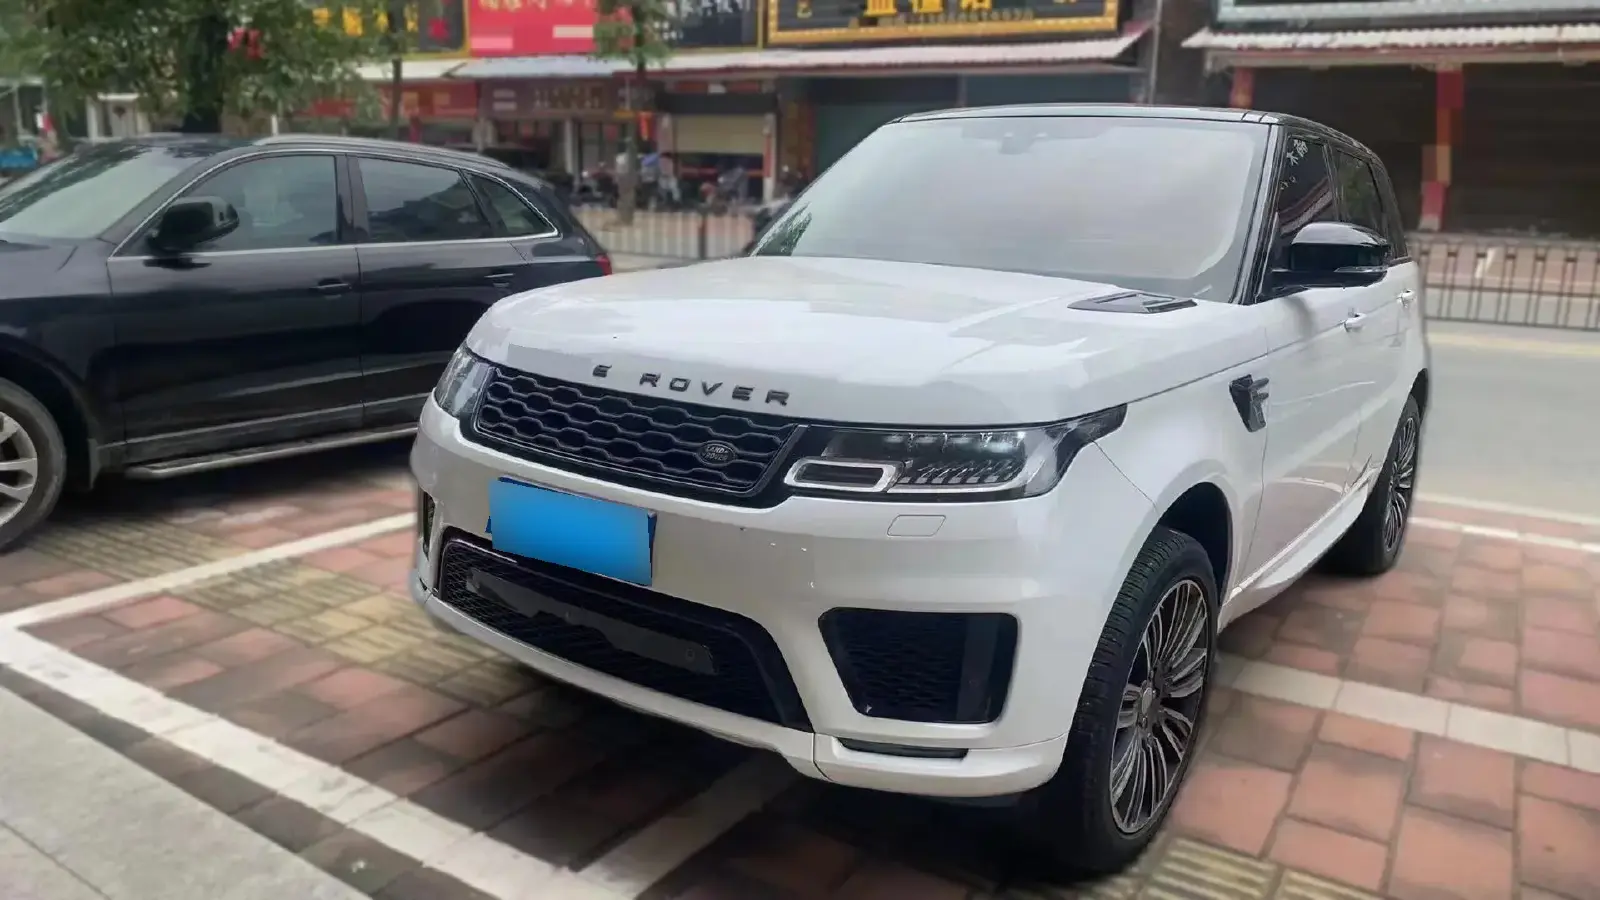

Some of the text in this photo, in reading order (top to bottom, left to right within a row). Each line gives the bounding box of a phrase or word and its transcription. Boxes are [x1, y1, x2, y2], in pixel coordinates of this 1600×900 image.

[593, 364, 790, 407] E ROVER
[705, 446, 724, 455] LAND
[706, 452, 728, 461] ROVER
